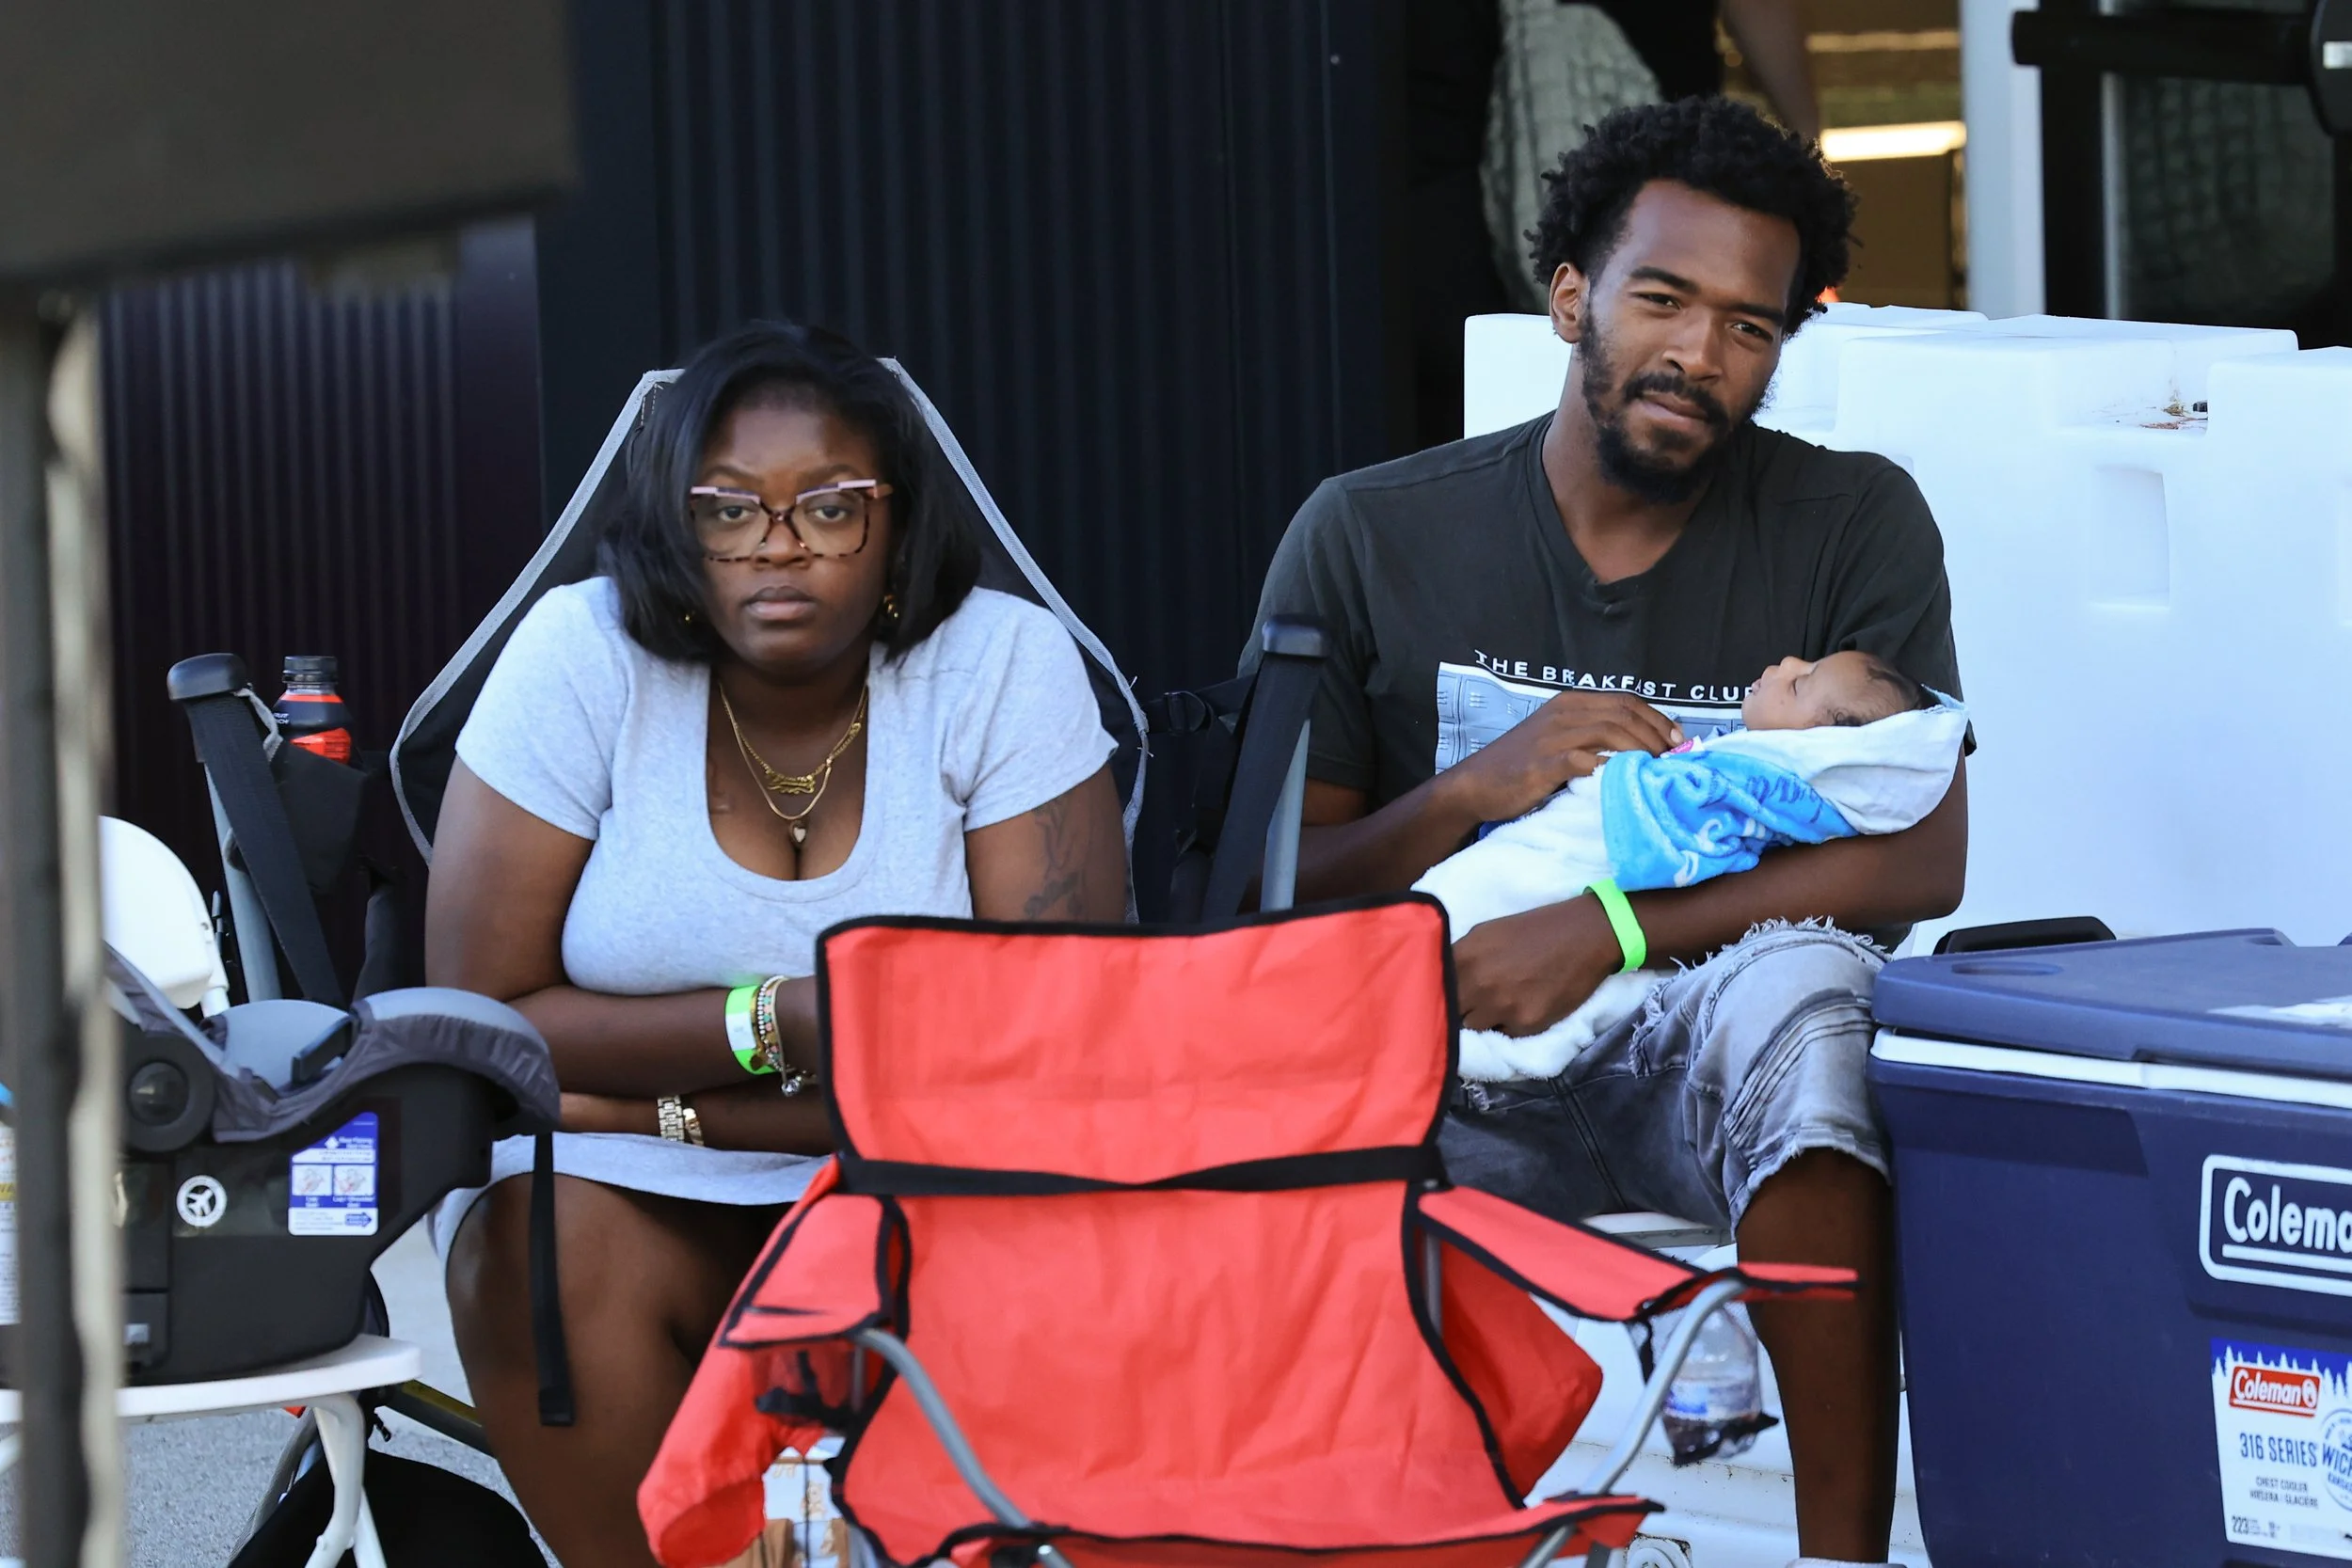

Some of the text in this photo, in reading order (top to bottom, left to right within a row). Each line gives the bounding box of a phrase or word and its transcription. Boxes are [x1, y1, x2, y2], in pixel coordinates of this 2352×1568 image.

[1474, 649, 1528, 676] THE
[2234, 1369, 2301, 1406] Coleman
[2240, 1433, 2317, 1467] 316 SERIES
